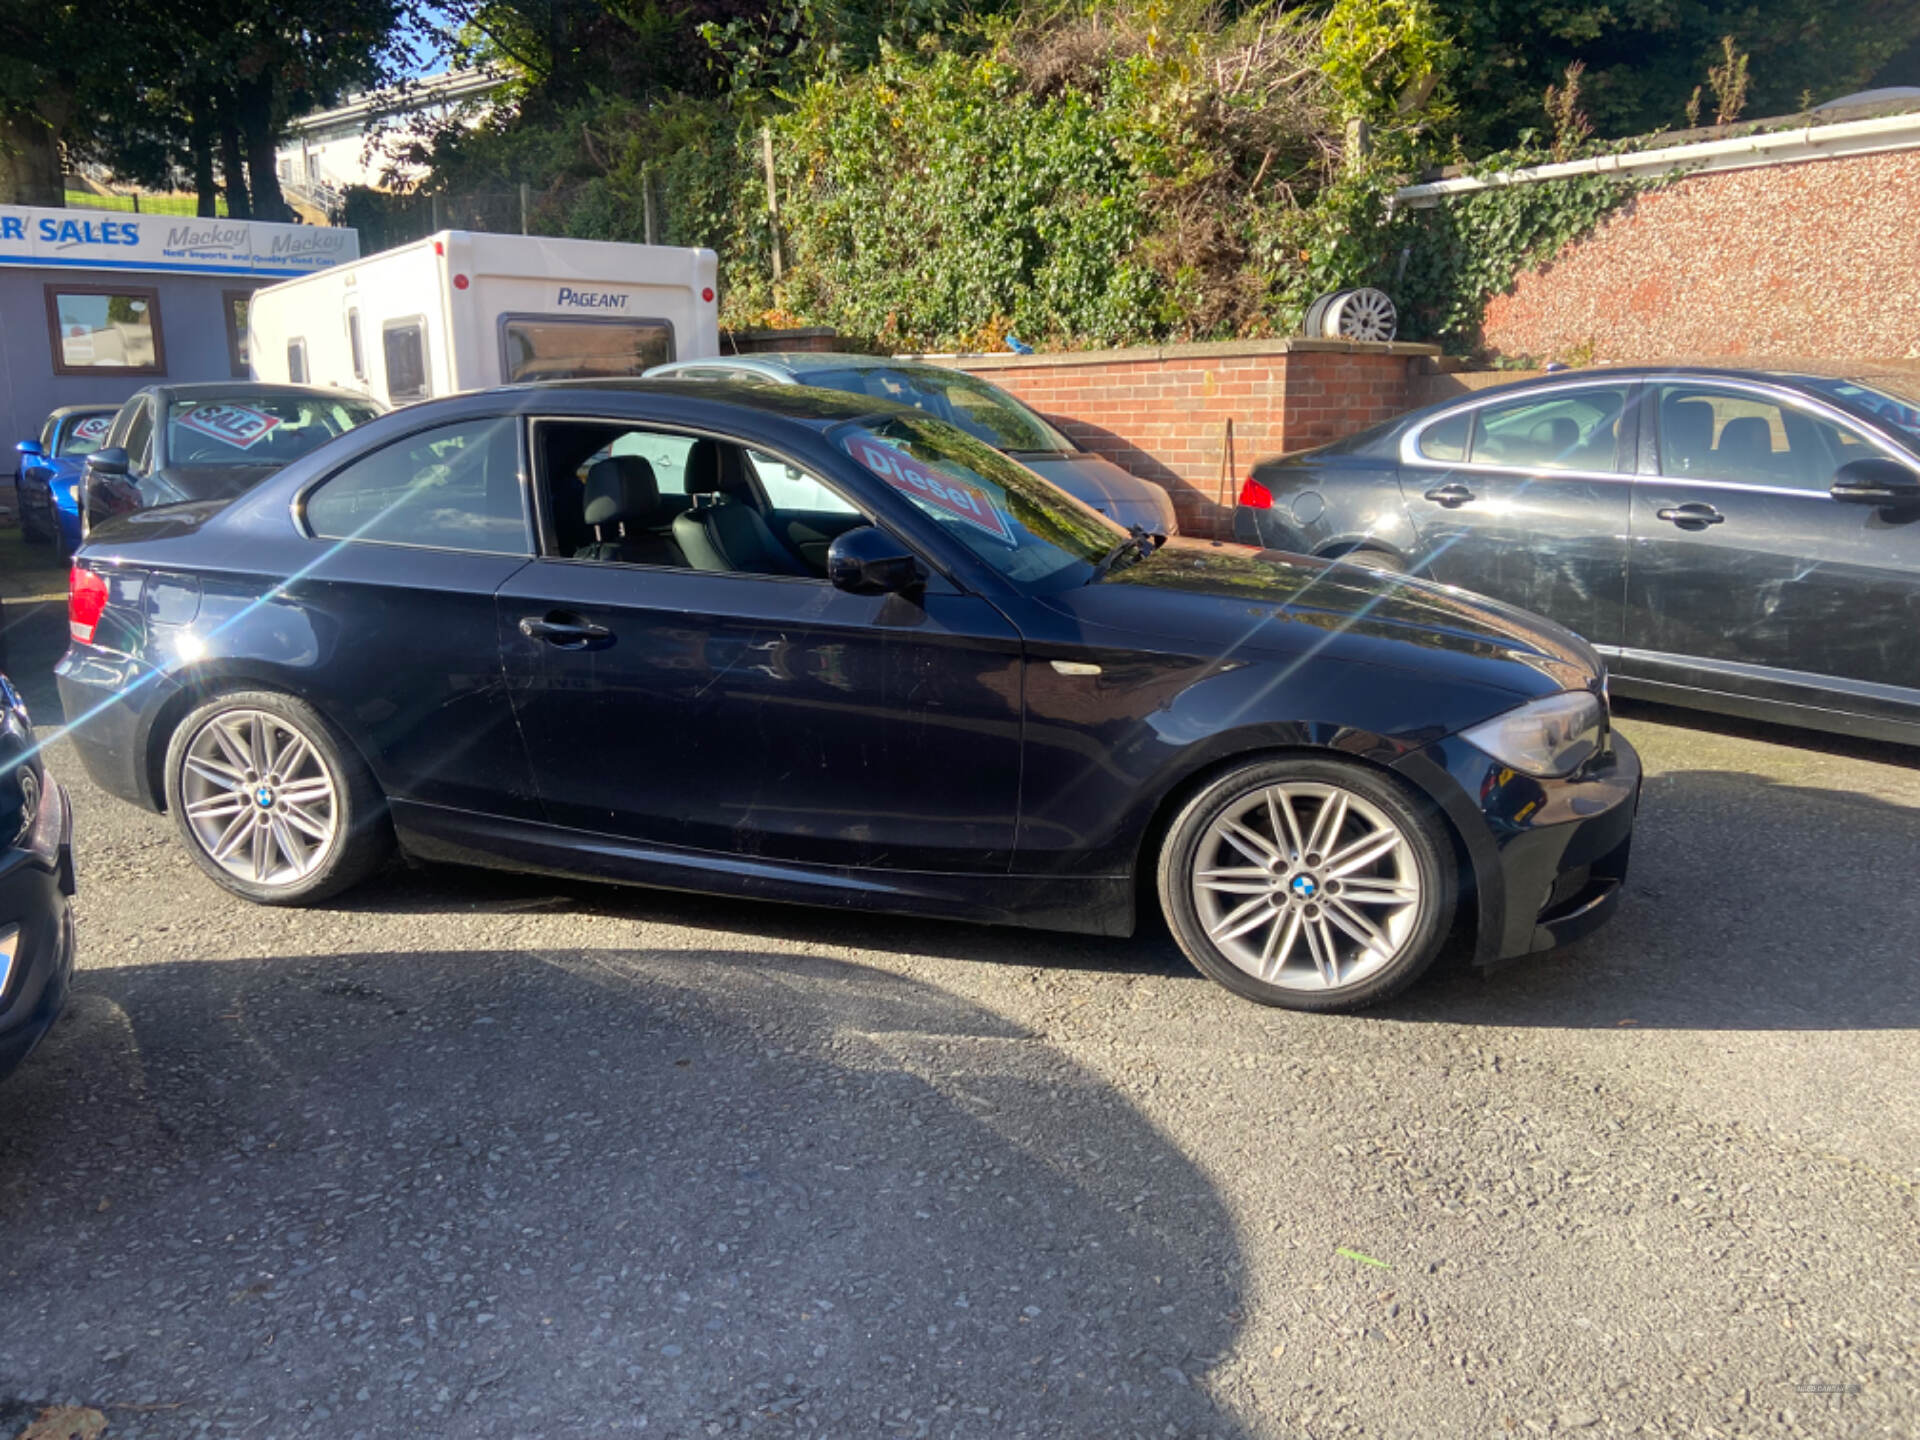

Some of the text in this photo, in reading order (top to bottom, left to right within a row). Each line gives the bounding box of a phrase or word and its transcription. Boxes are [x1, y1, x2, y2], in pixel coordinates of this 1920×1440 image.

[39, 218, 140, 246] SALES
[252, 255, 287, 265] Quality
[316, 258, 336, 266] Cars
[557, 287, 629, 308] PAGEANT
[193, 406, 264, 437] SALE
[862, 446, 982, 515] Diesel
